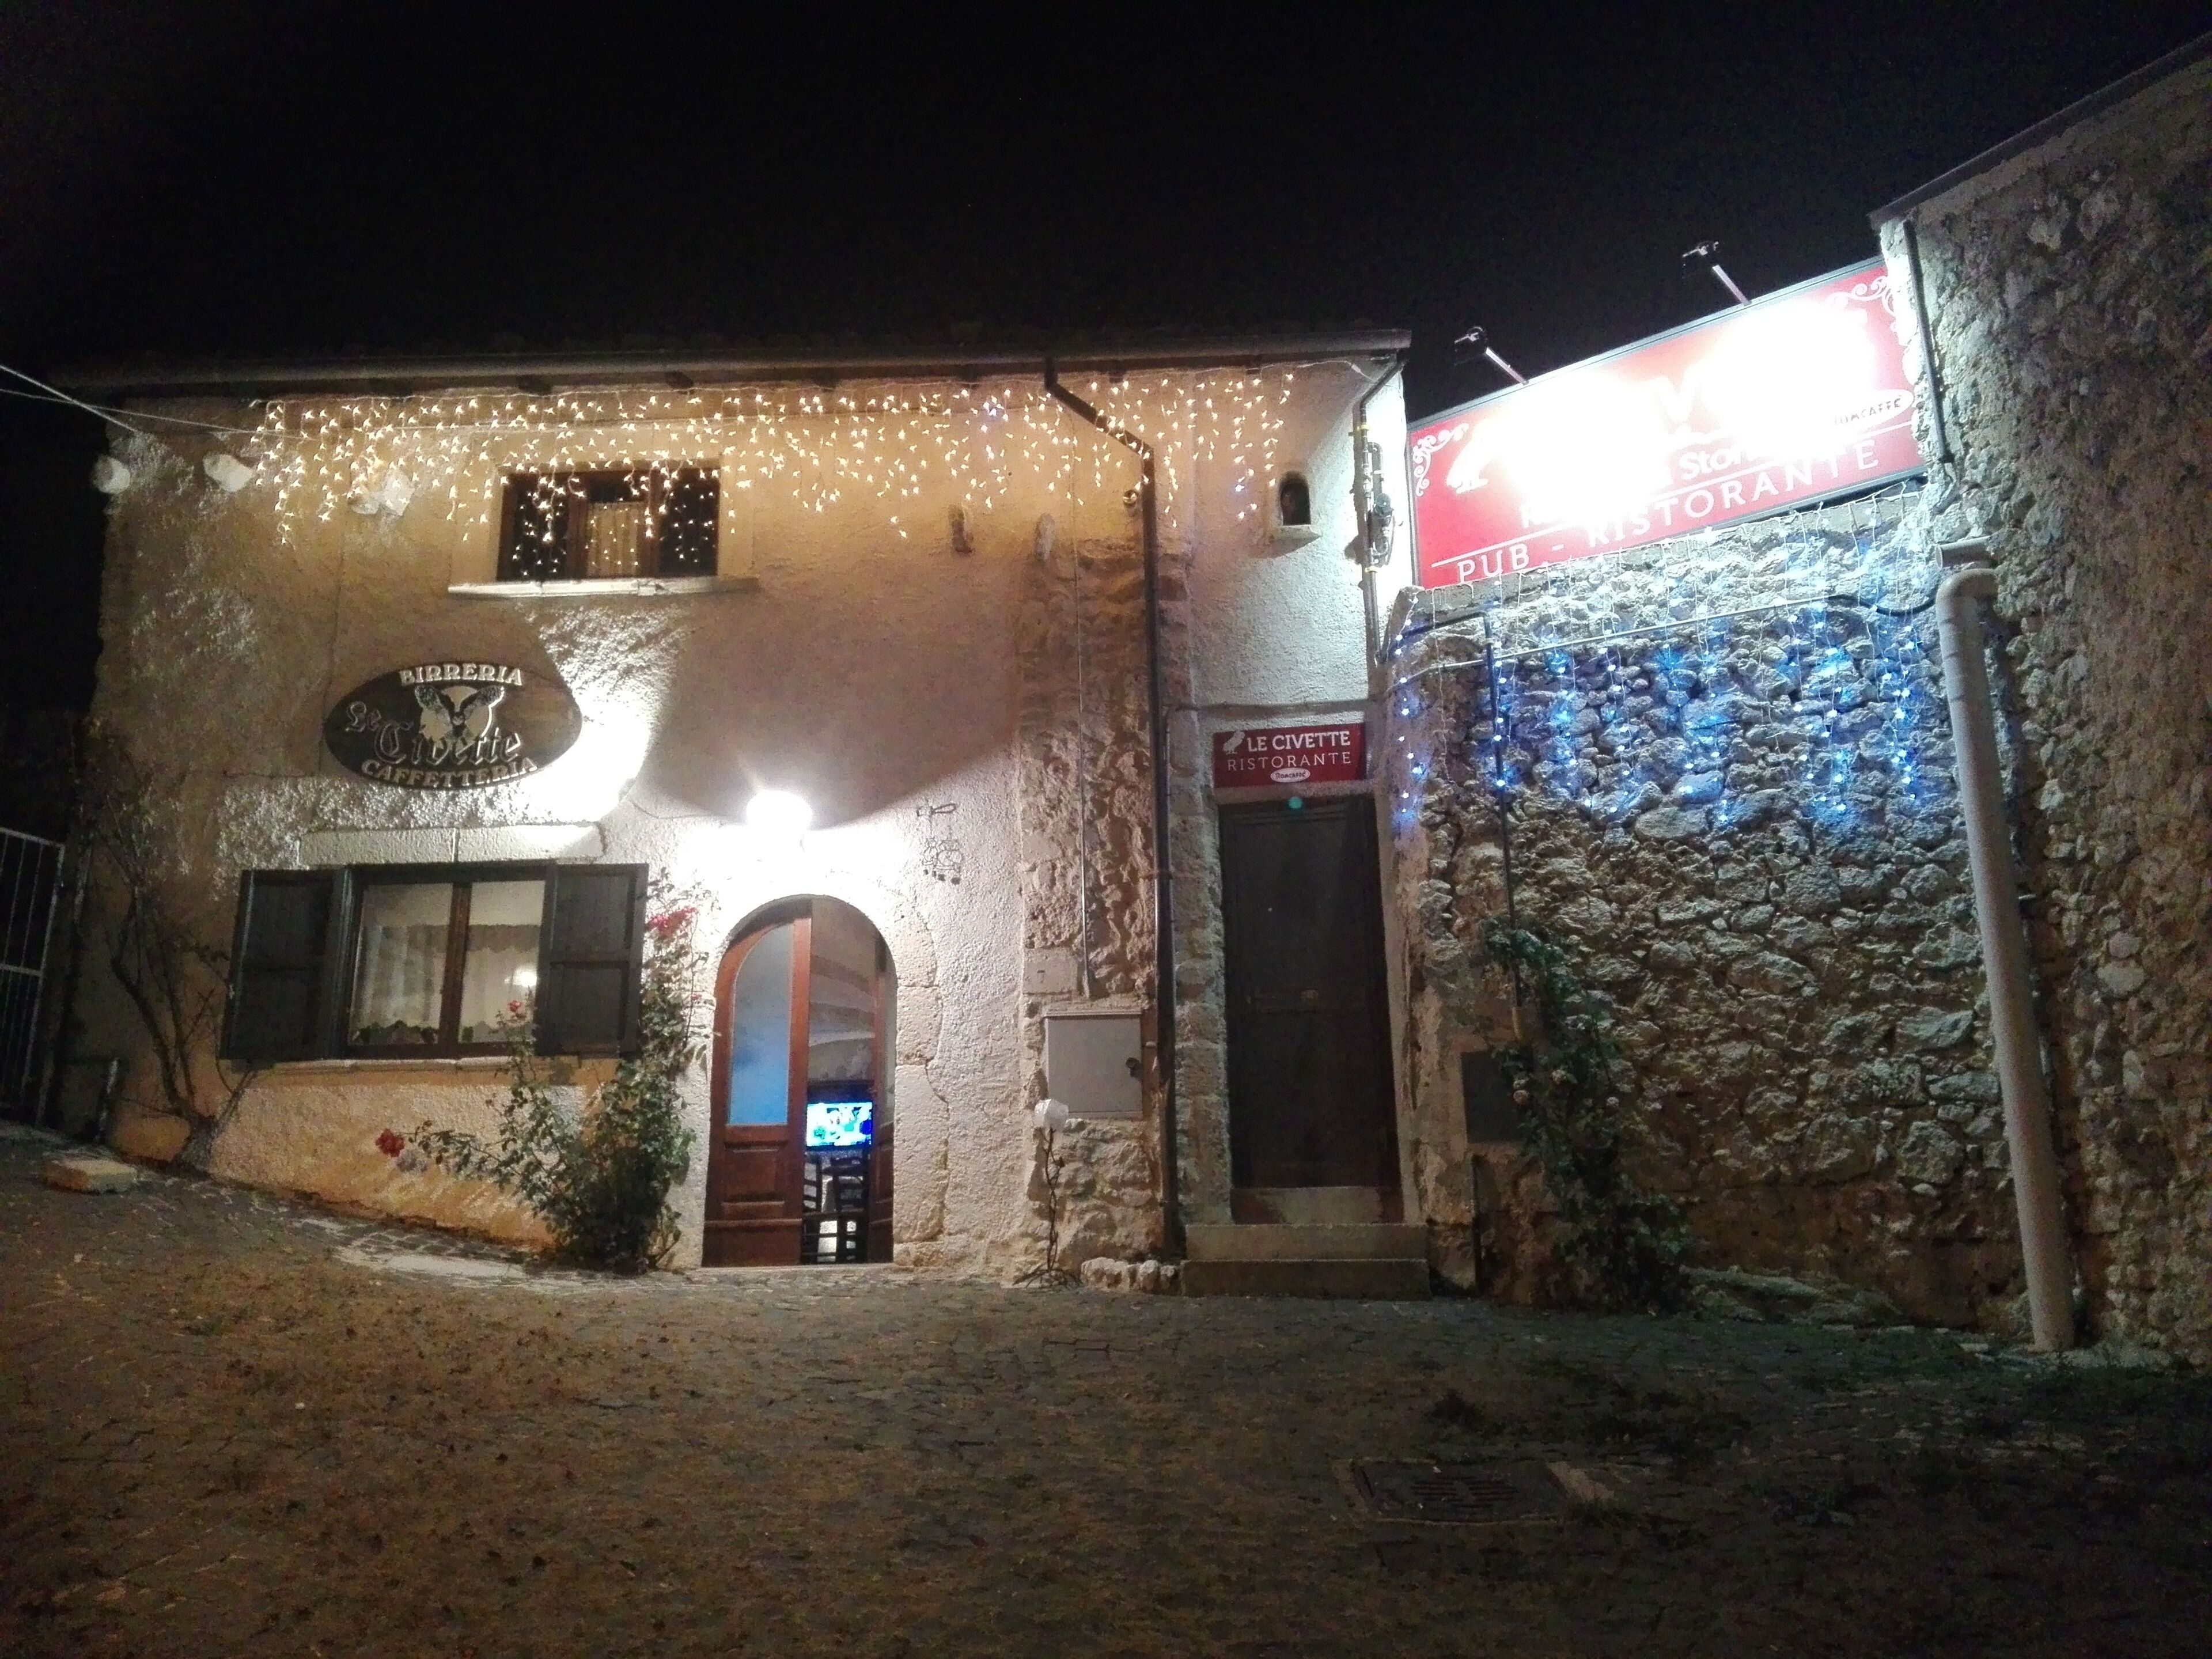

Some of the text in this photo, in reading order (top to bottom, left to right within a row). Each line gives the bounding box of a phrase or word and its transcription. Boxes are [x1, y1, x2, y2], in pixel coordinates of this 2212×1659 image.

[1457, 543, 1529, 583] PUB
[1585, 440, 1880, 548] RISTORANTE
[399, 662, 523, 686] BIRRERIA
[1247, 730, 1351, 752] LE CIVETTE
[361, 756, 538, 788] CAFFETTERIA
[1227, 751, 1351, 771] RISTORANTE
